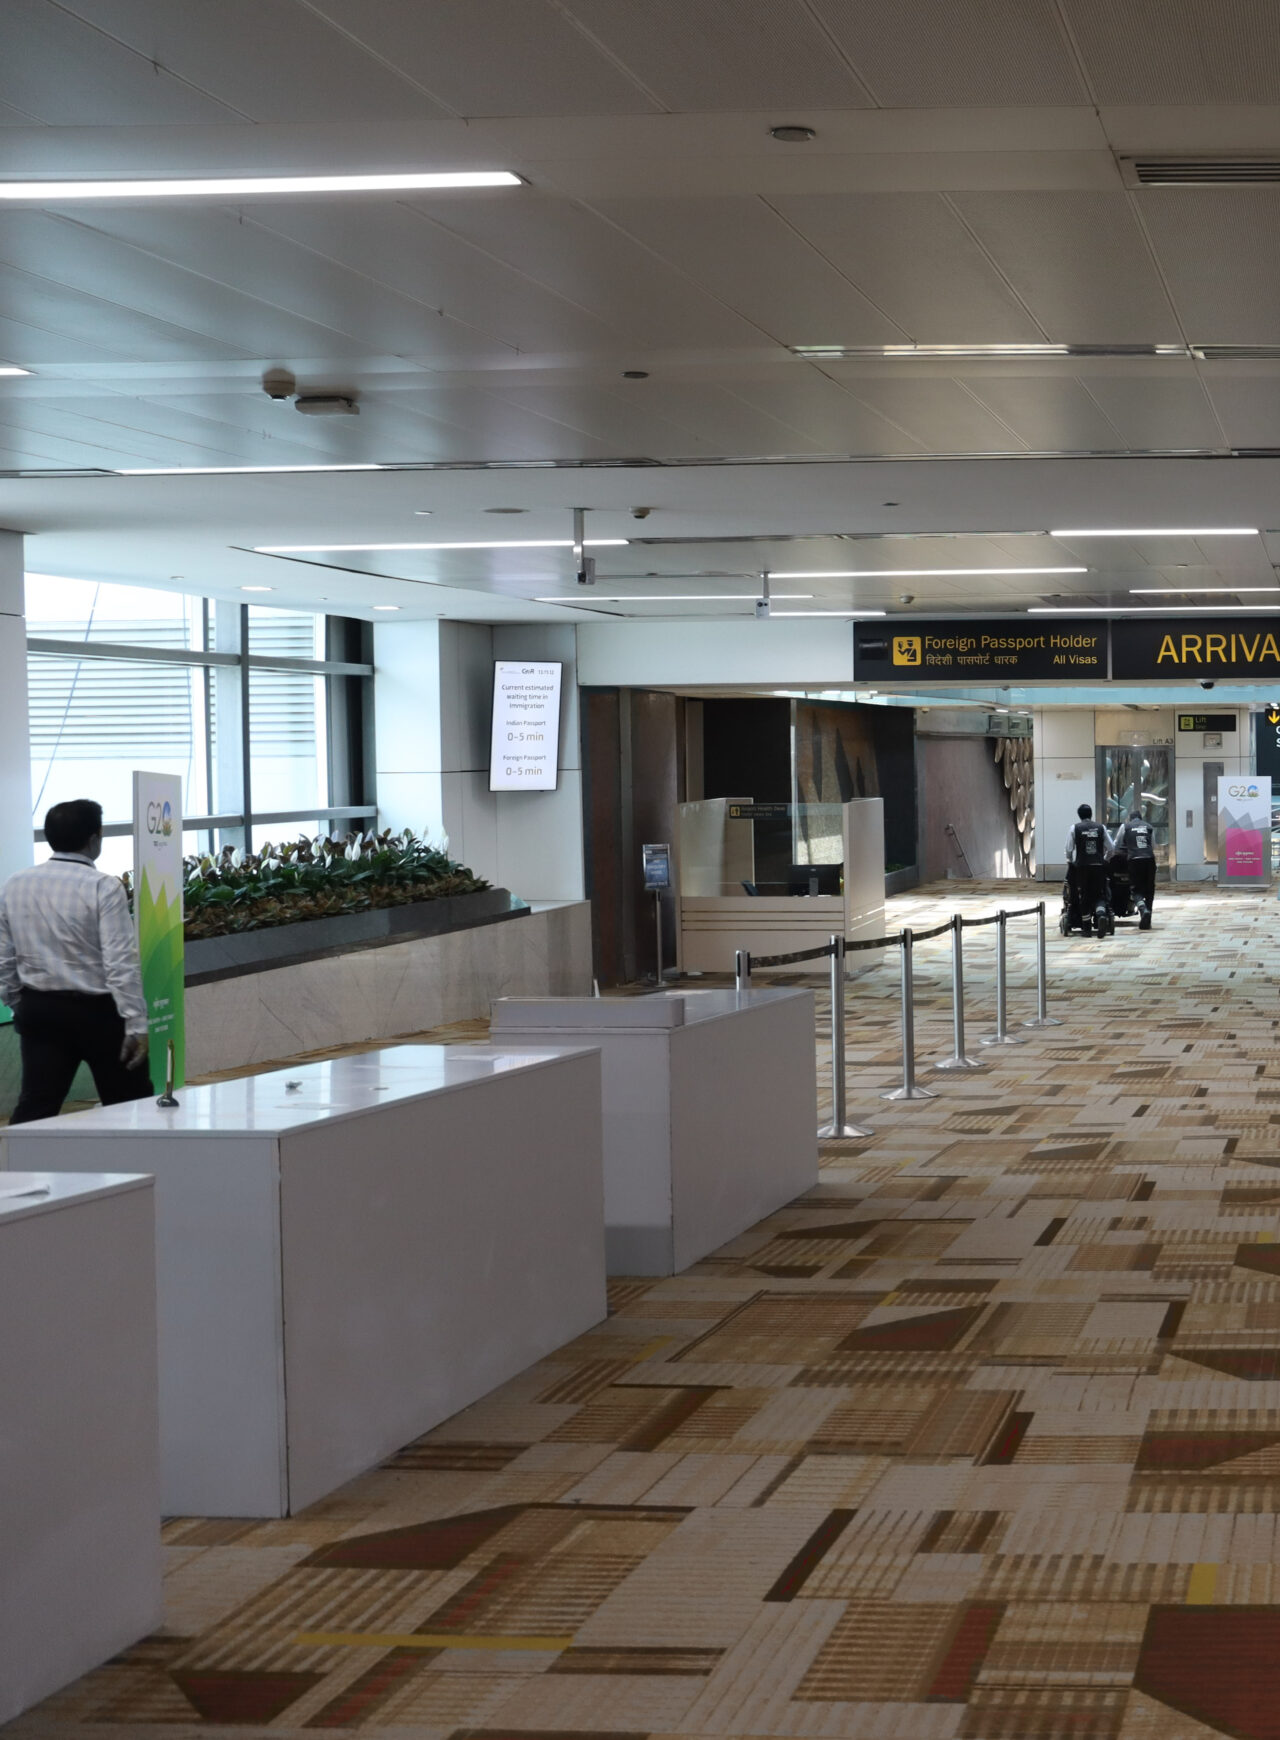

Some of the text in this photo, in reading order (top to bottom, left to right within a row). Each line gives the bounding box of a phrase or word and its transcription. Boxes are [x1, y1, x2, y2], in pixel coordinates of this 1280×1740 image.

[925, 635, 1098, 651] Foreign Passport Holder
[925, 653, 1018, 665] विदेशी पासपोर्ट धारक
[1053, 655, 1098, 665] All Visas
[506, 693, 528, 701] waiting
[1195, 716, 1207, 724] Lift
[526, 732, 544, 741] min
[524, 767, 543, 776] min
[146, 801, 173, 837] G20
